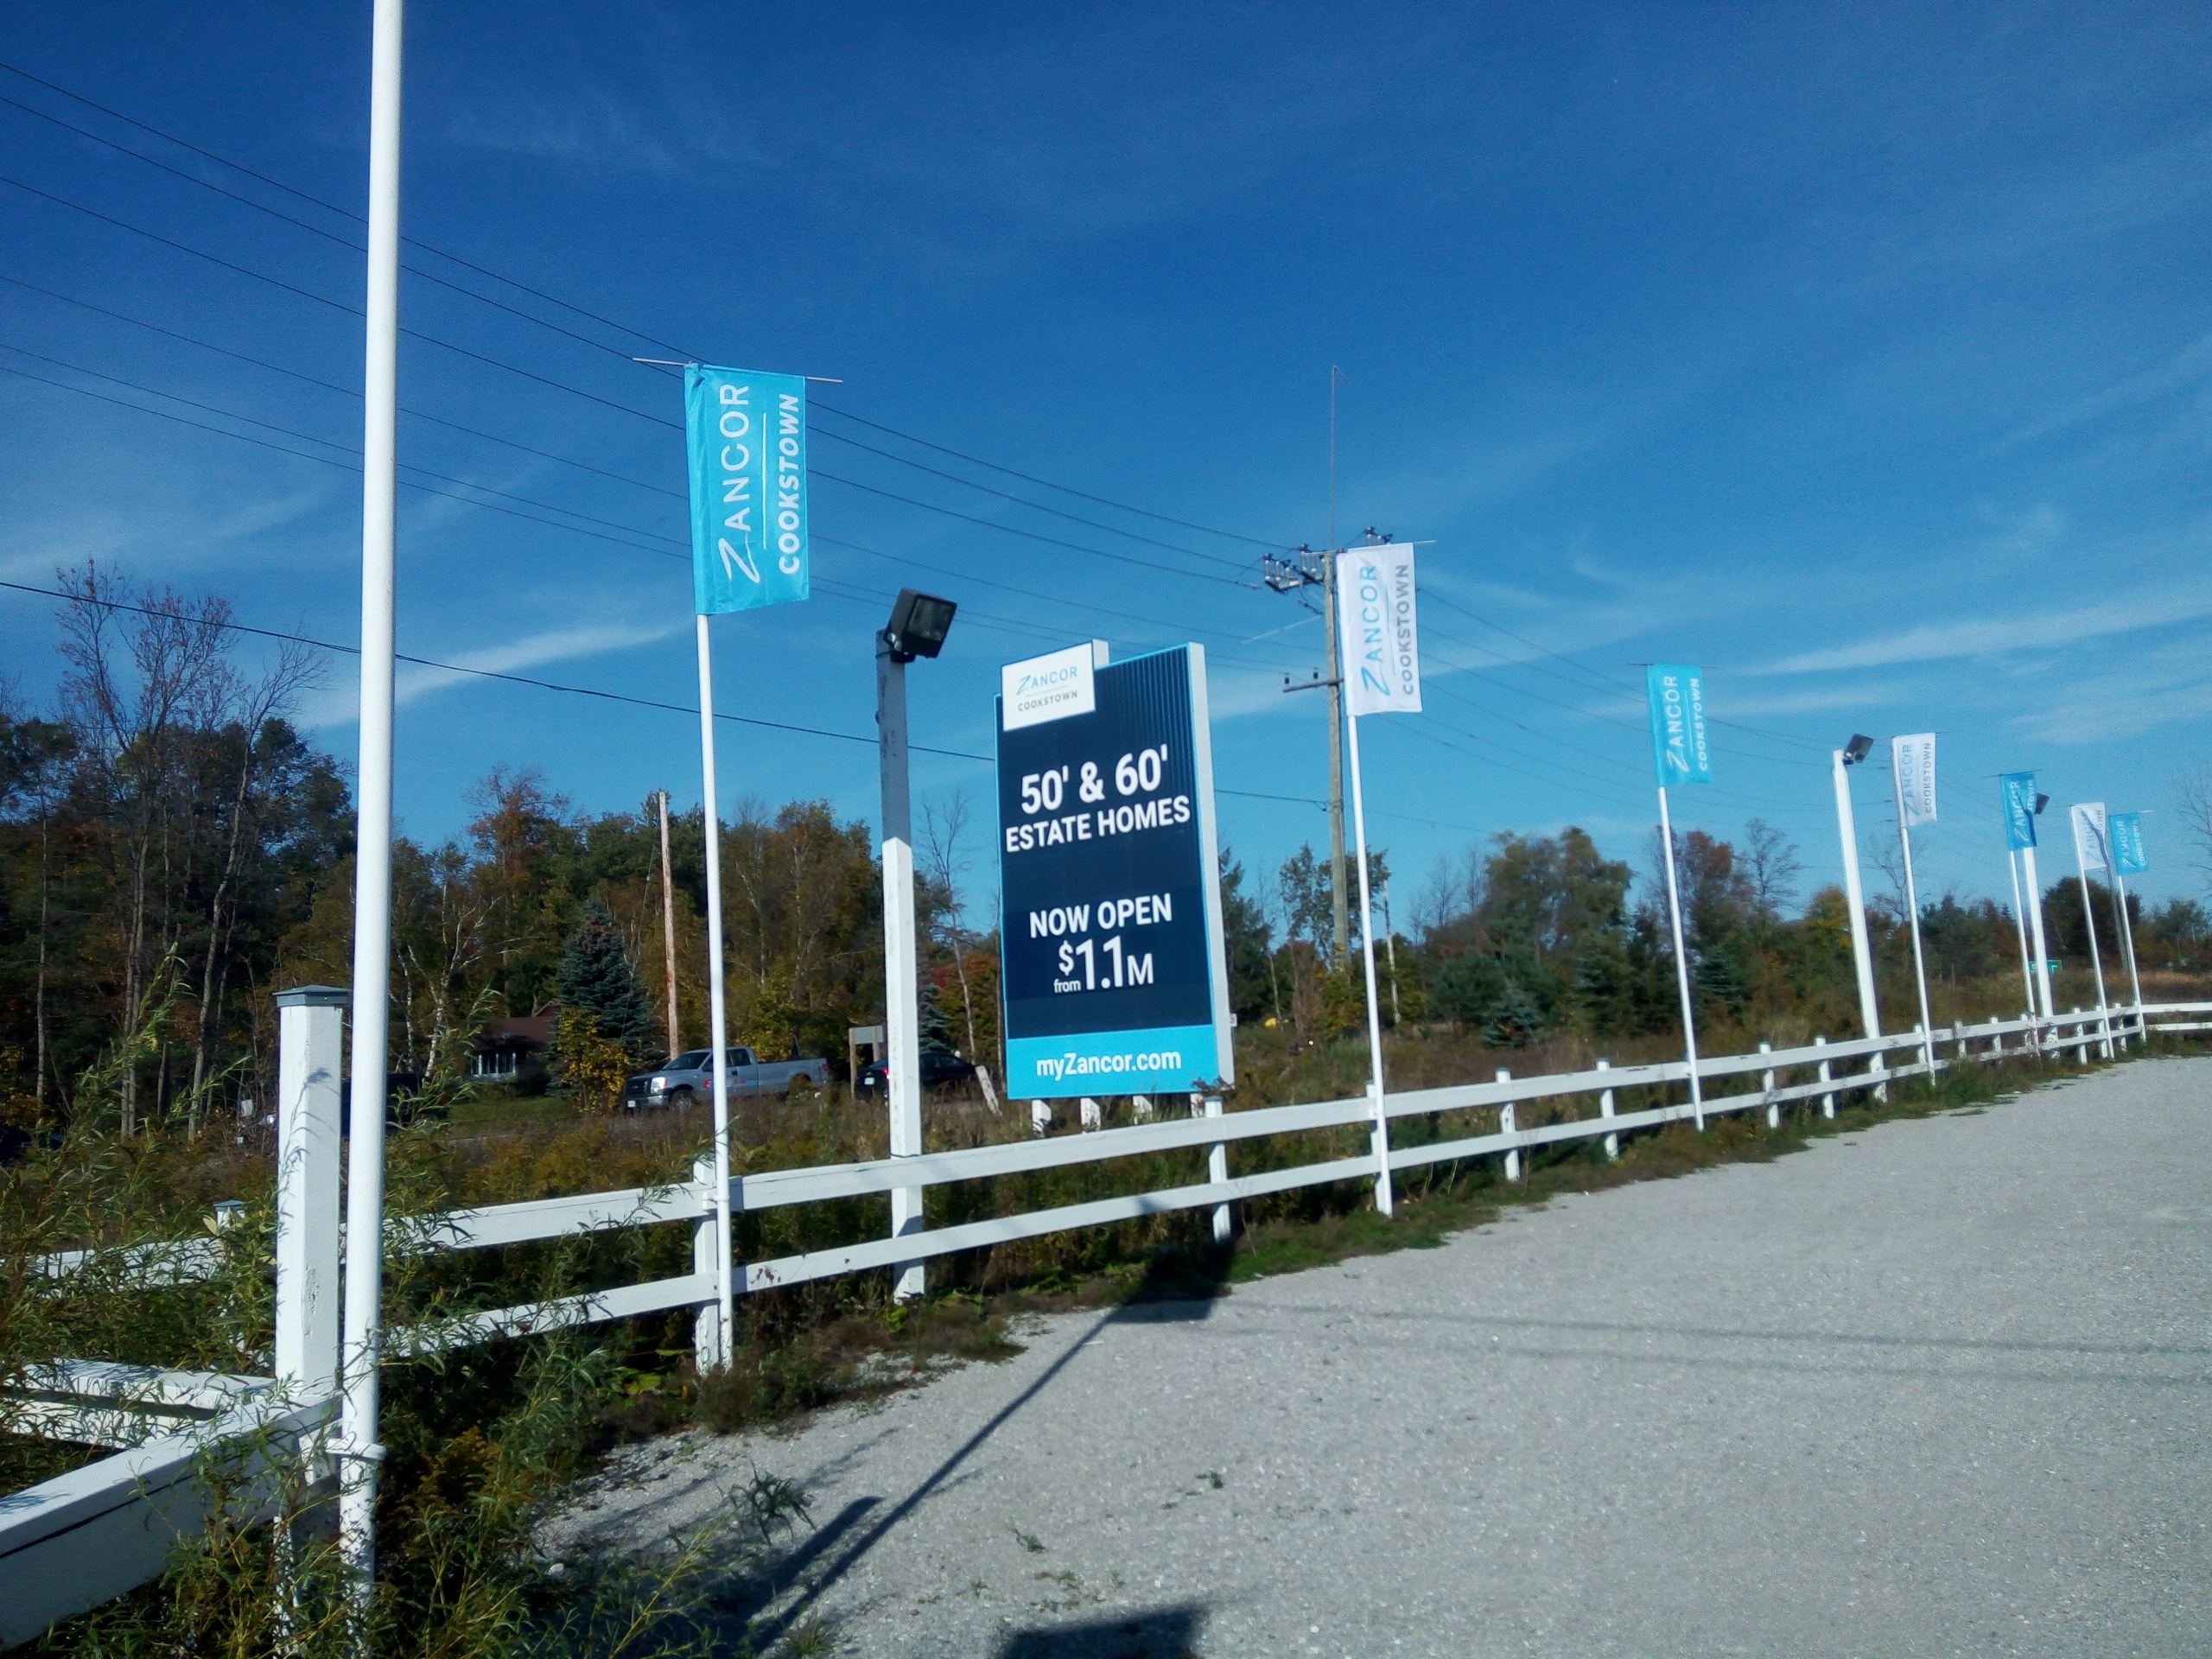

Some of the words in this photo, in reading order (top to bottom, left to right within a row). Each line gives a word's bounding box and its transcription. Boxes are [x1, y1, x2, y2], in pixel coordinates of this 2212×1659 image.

[718, 384, 760, 583] ZANCOR
[778, 393, 800, 575] COOKSTOWN
[1359, 564, 1391, 696] ZANCOR
[1395, 564, 1414, 695] COOKSTOWN
[1016, 666, 1078, 696] ZANCOR
[1018, 690, 1078, 712] COOKSTOWN
[1662, 676, 1690, 772] ZANCOR
[1690, 677, 1708, 771] COOKSTOWN
[1020, 765, 1069, 814] 50'
[1079, 761, 1106, 804] &
[1115, 743, 1167, 796] 60'
[1923, 742, 1933, 813] COOKSTOWN
[1006, 812, 1092, 853] ESTATE
[1097, 795, 1191, 836] HOMES
[1029, 904, 1090, 938] NOW
[1097, 893, 1173, 930] OPEN
[1053, 978, 1082, 994] from
[1037, 1051, 1182, 1081] myZancor.com
